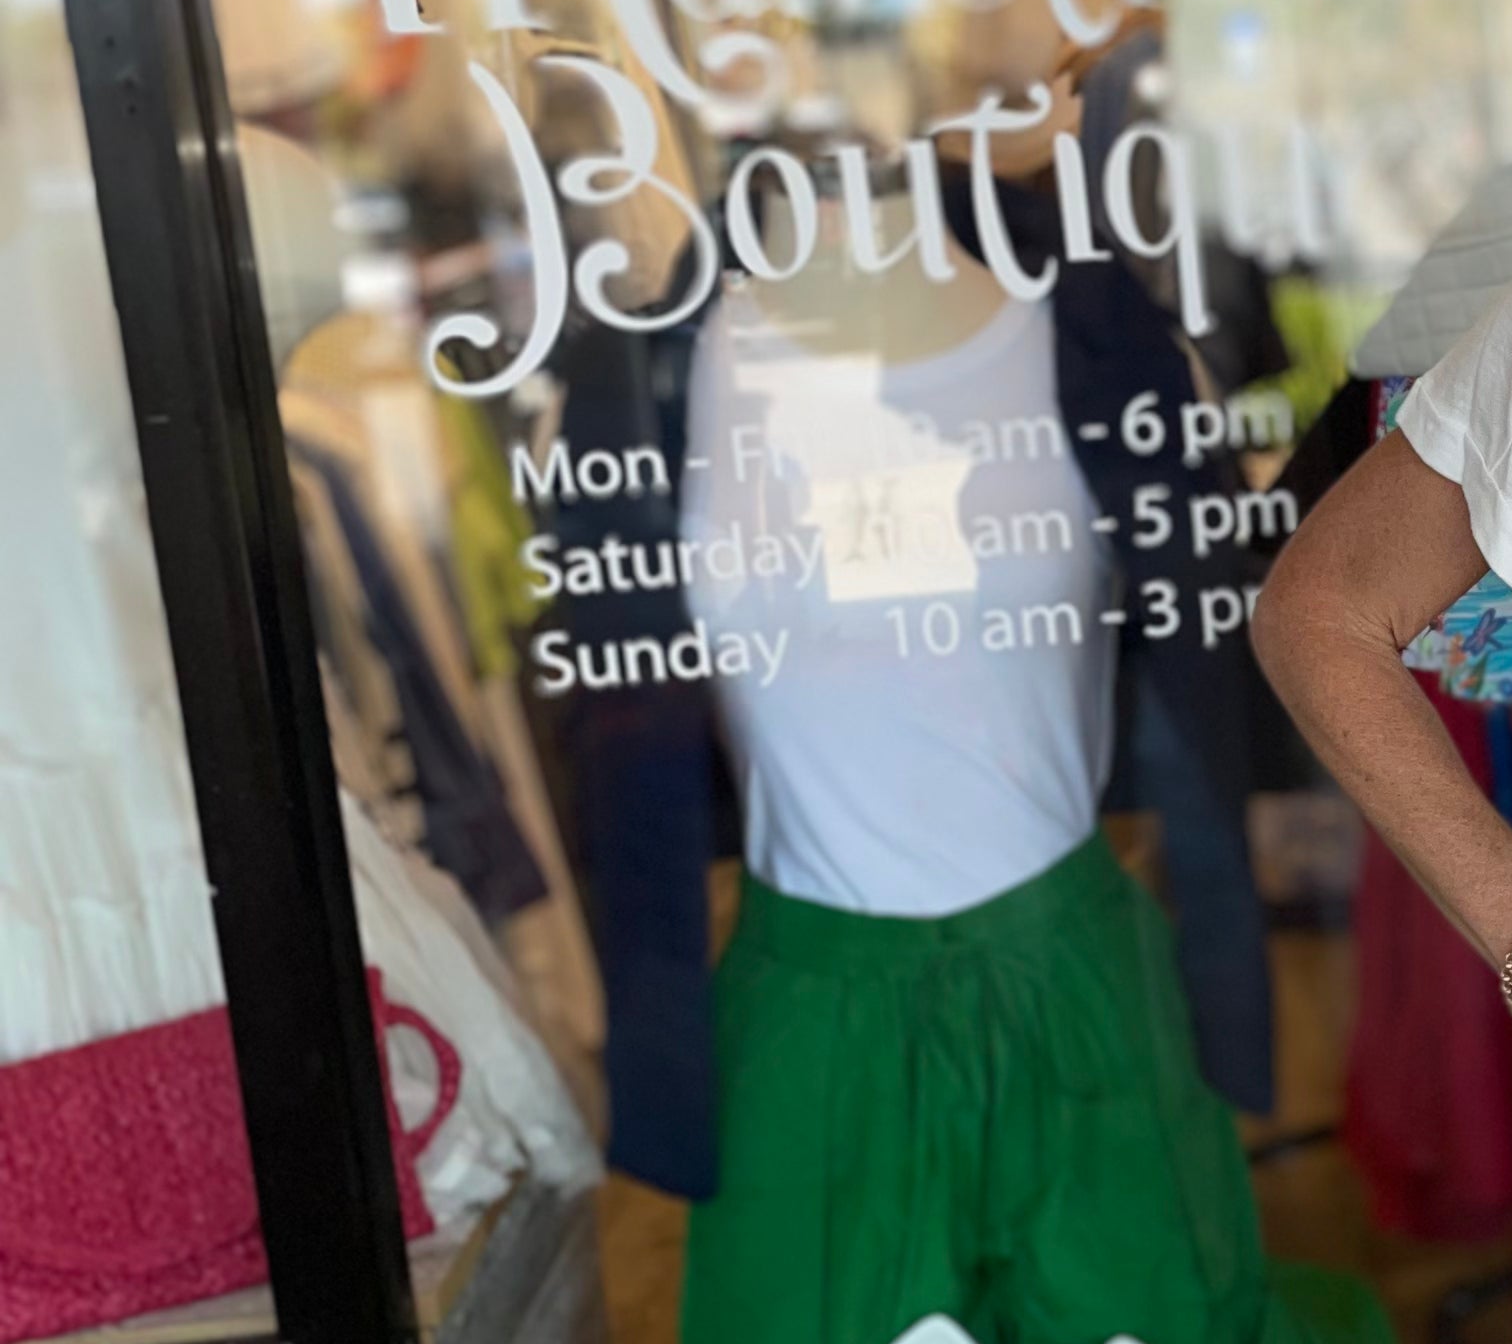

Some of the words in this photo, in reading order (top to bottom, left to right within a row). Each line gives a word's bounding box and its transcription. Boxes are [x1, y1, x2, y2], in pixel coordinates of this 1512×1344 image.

[509, 437, 672, 504] Mon
[969, 414, 1063, 464] am
[1120, 391, 1163, 455] 6
[1180, 393, 1295, 467] pm
[522, 522, 824, 599] Saturday
[974, 509, 1072, 559] am
[1132, 486, 1172, 547] 5
[1189, 489, 1299, 558] pm
[534, 619, 790, 694] Sunday
[885, 601, 962, 660] 10
[982, 601, 1083, 651] am
[1142, 581, 1180, 638] 3
